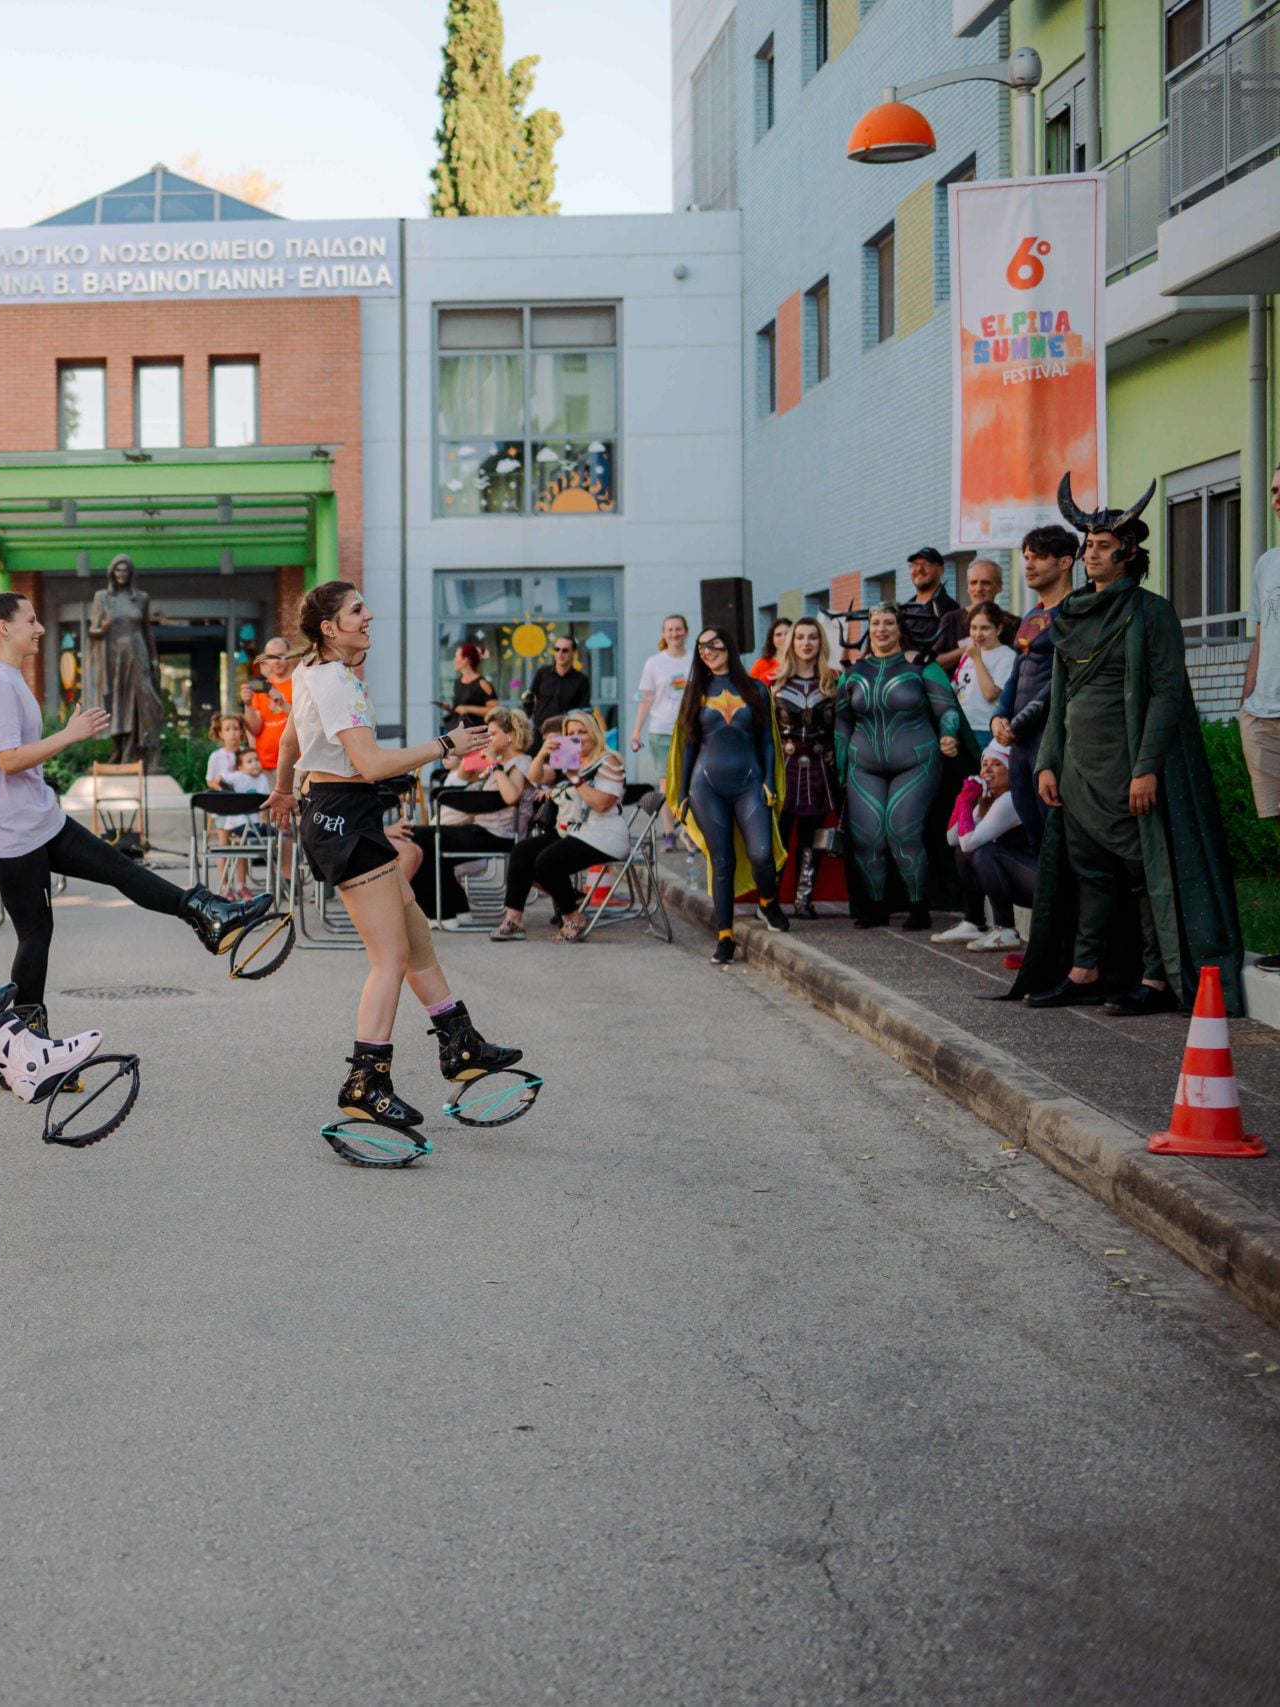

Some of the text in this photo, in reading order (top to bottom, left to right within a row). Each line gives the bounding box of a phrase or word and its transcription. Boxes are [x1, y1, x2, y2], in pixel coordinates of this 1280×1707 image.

[99, 239, 275, 263] ΝΟΣΟΚΟΜΕΙΟ
[285, 236, 387, 259] ΠΑΙΔΩΝ
[980, 310, 1071, 338] ELPIDA
[973, 334, 1083, 364] SUMMER
[1003, 361, 1070, 386] FESTIVAL
